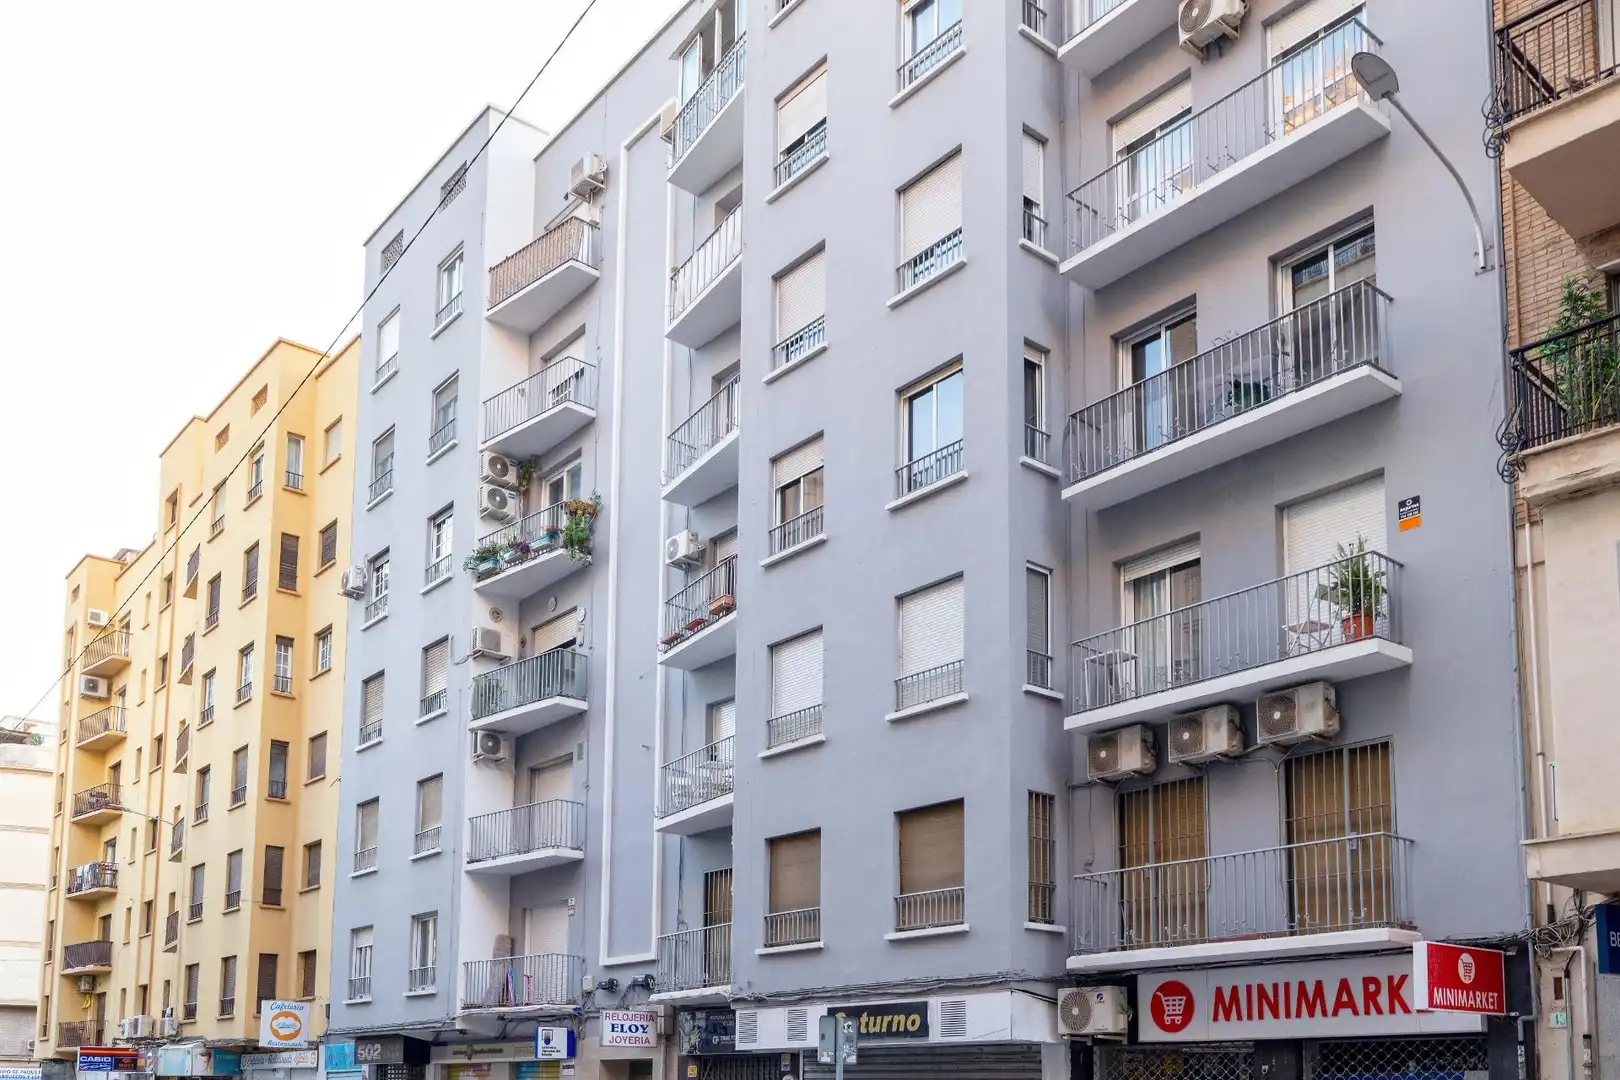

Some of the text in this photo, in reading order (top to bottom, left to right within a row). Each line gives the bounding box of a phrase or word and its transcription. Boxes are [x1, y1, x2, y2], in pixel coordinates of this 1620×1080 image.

[1212, 974, 1433, 1022] MINIMARK
[1432, 986, 1499, 1011] MINIMARKET
[604, 1012, 655, 1023] RELOJERIA
[834, 1010, 921, 1034] turno
[610, 1023, 650, 1034] ELOY
[608, 1035, 651, 1045] JOYERIA
[357, 1043, 381, 1061] 502
